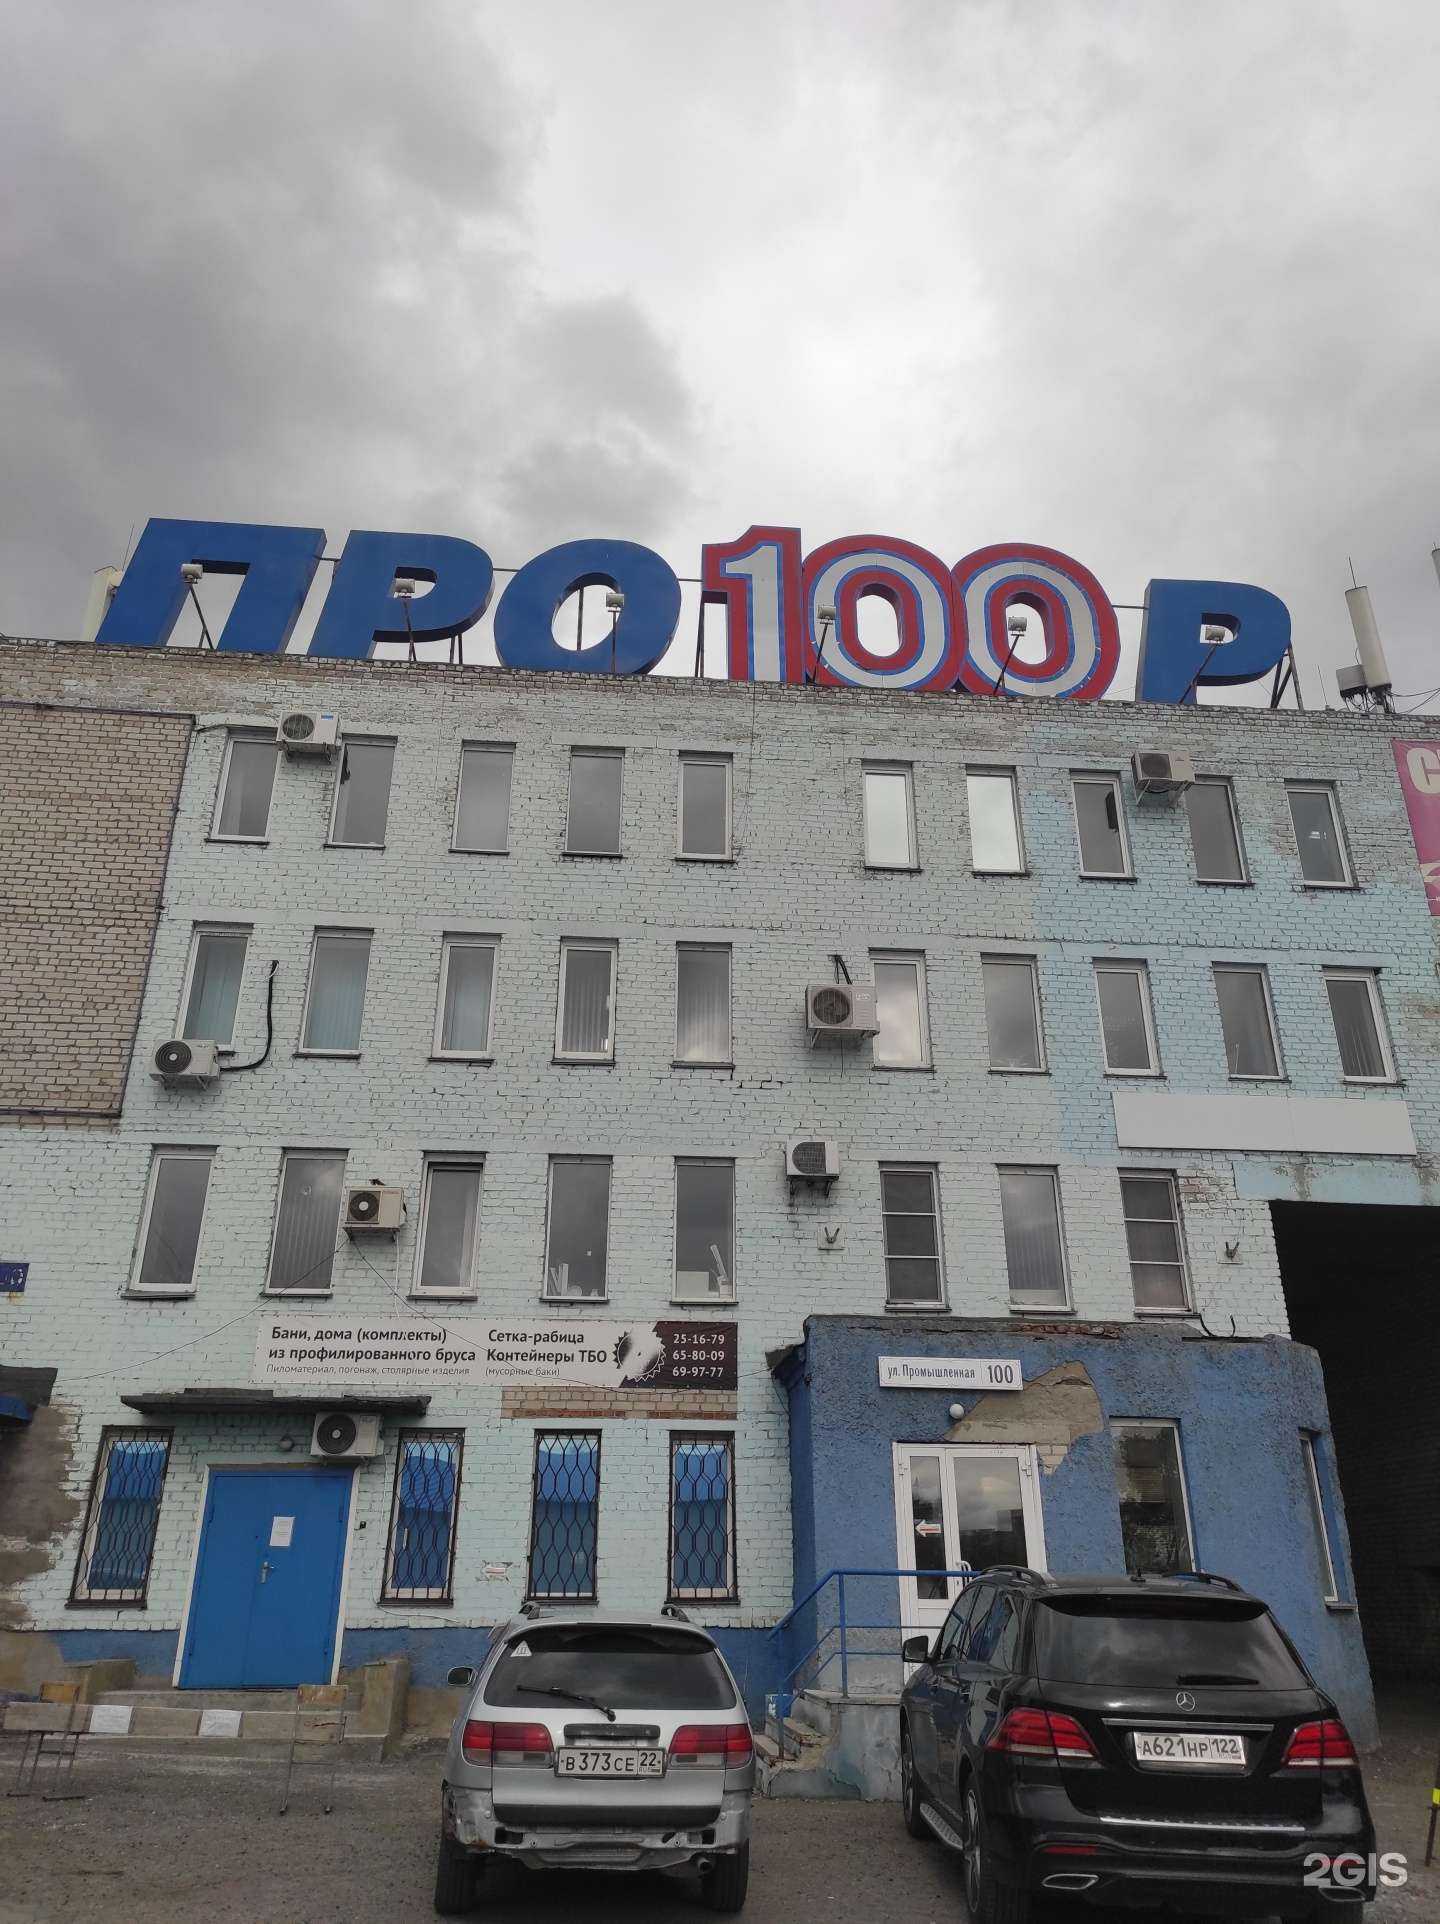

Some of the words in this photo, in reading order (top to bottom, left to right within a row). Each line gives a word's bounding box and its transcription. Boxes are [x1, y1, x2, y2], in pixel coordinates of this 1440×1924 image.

[271, 1326, 311, 1342] Бани,
[314, 1329, 352, 1342] дома
[488, 1329, 584, 1344] Сетка-рабица
[673, 1333, 725, 1345] 25-16-79
[268, 1349, 285, 1359] из
[289, 1347, 431, 1363] профилированного
[435, 1348, 476, 1363] бруса
[487, 1349, 575, 1364] Контейнеры
[579, 1349, 607, 1363] ТБО
[672, 1350, 725, 1361] 65-80-09
[266, 1364, 337, 1375] Пиломатериал,
[672, 1366, 724, 1377] 69-97-77
[887, 1366, 900, 1379] ул.
[902, 1364, 976, 1380] Промышленная
[987, 1364, 1014, 1384] 100
